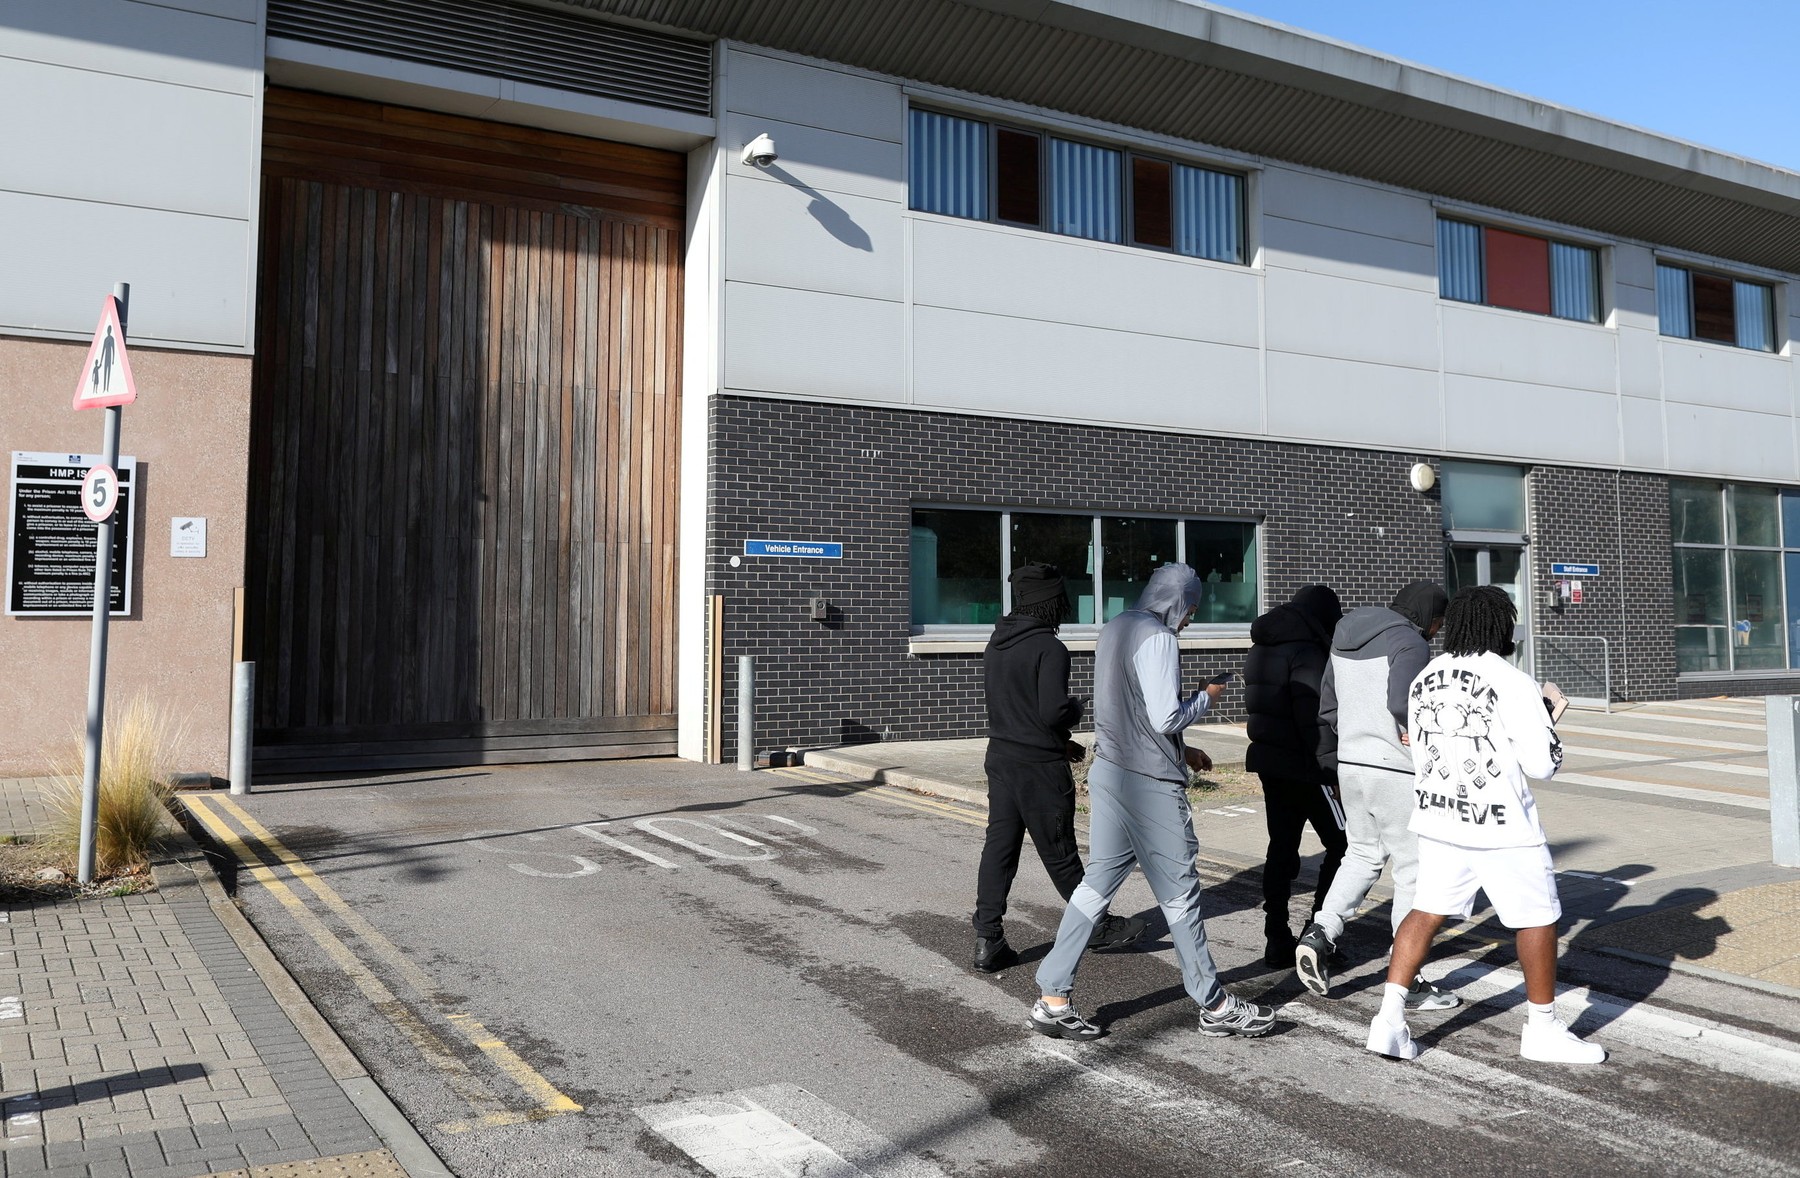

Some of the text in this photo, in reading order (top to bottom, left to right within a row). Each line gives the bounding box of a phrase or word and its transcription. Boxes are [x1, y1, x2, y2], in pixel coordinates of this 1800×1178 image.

[50, 468, 74, 478] HMP
[93, 478, 107, 508] 5
[765, 544, 824, 554] Vehicle Entrance
[1411, 669, 1499, 714] BELIEVE
